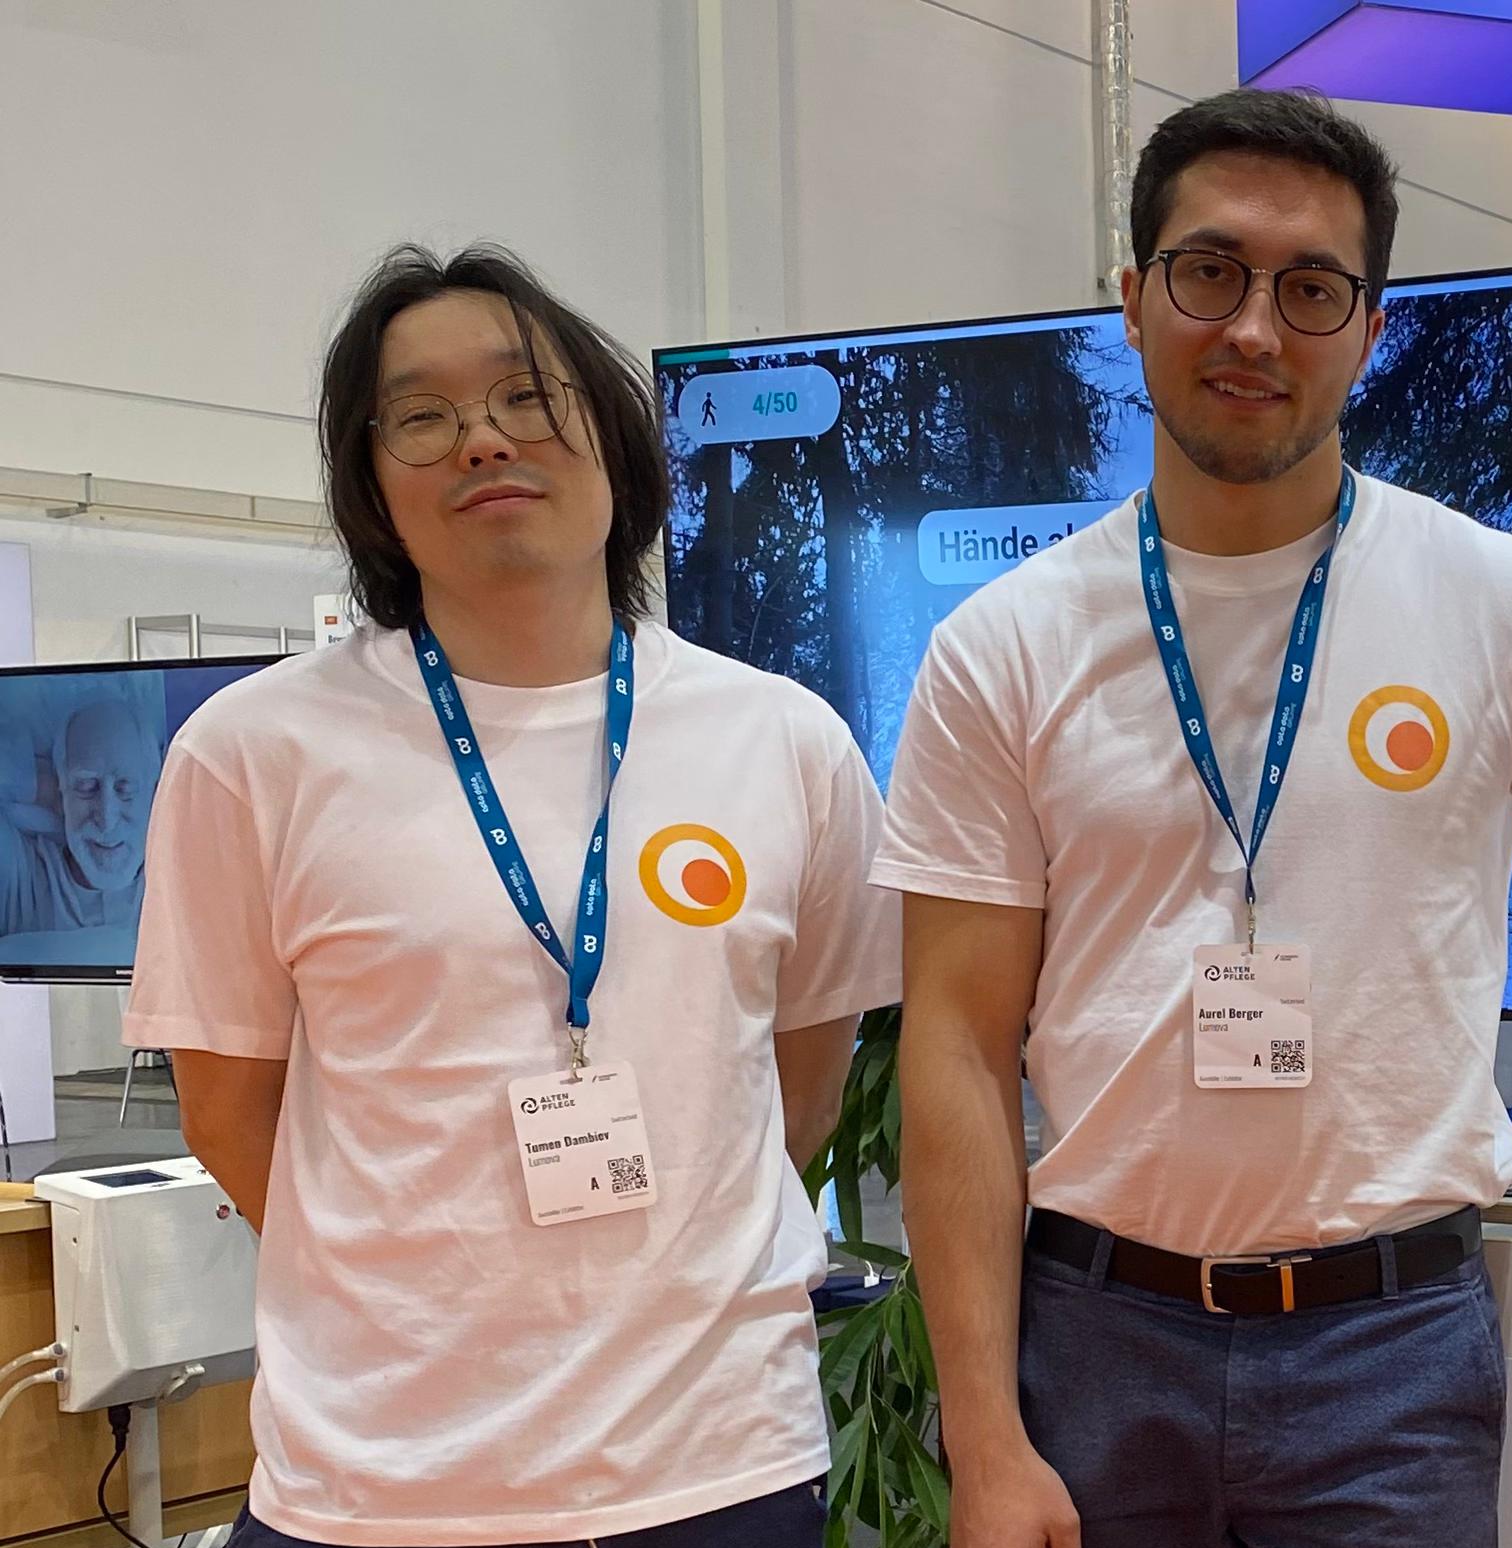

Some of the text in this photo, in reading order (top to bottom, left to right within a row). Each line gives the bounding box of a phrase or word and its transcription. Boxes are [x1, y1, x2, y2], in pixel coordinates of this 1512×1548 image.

[752, 391, 798, 416] 4/50
[939, 525, 1039, 563] Hände
[1223, 973, 1256, 981] PFLEGE
[1199, 1008, 1263, 1021] Aurel Berger
[1253, 1054, 1261, 1067] A
[540, 1093, 569, 1103] ALTEN
[541, 1100, 576, 1111] PFLEGE
[591, 1177, 600, 1190] A
